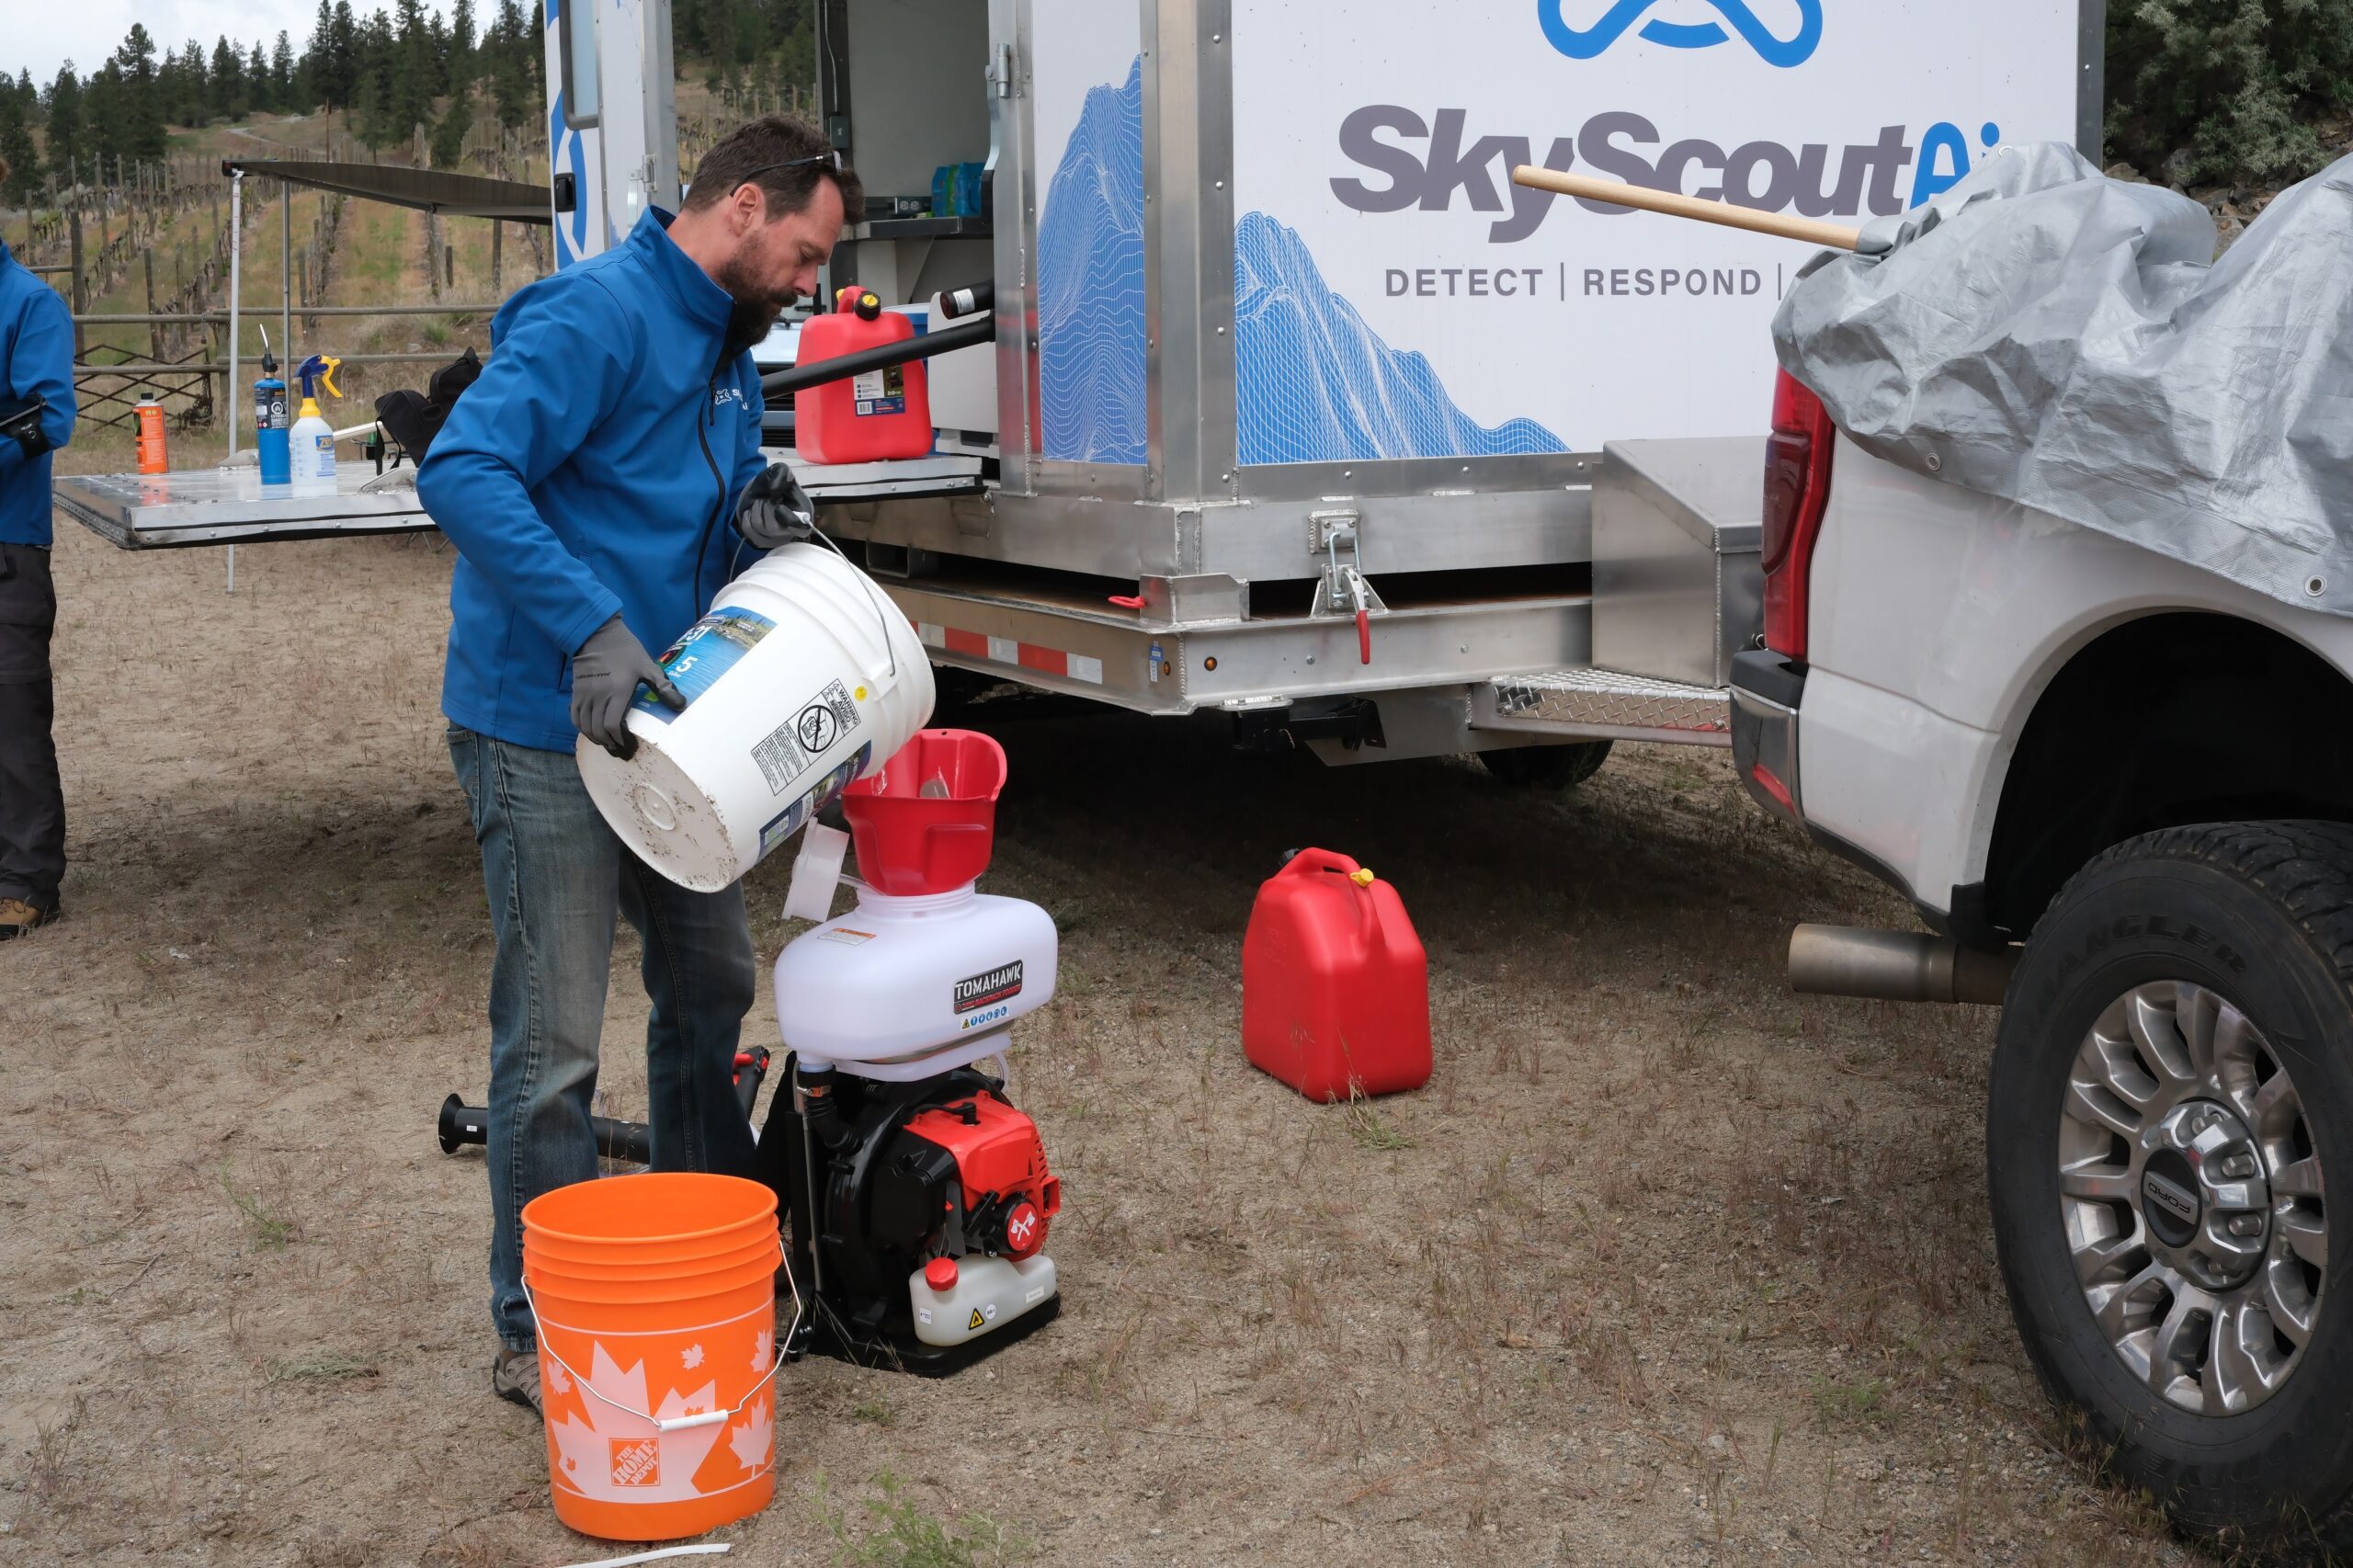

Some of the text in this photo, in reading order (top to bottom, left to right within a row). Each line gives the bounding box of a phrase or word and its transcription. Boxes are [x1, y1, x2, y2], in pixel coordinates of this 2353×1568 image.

[1385, 268, 1761, 296] DETECT RESPOND
[676, 656, 699, 673] 5
[837, 700, 851, 723] AVISO
[838, 688, 858, 725] WARNING
[955, 962, 1022, 1000] TOMAHAWK
[2148, 1182, 2191, 1214] FORD
[613, 1440, 656, 1484] HOME
[617, 1445, 634, 1462] THE
[630, 1456, 657, 1485] DEPOT
